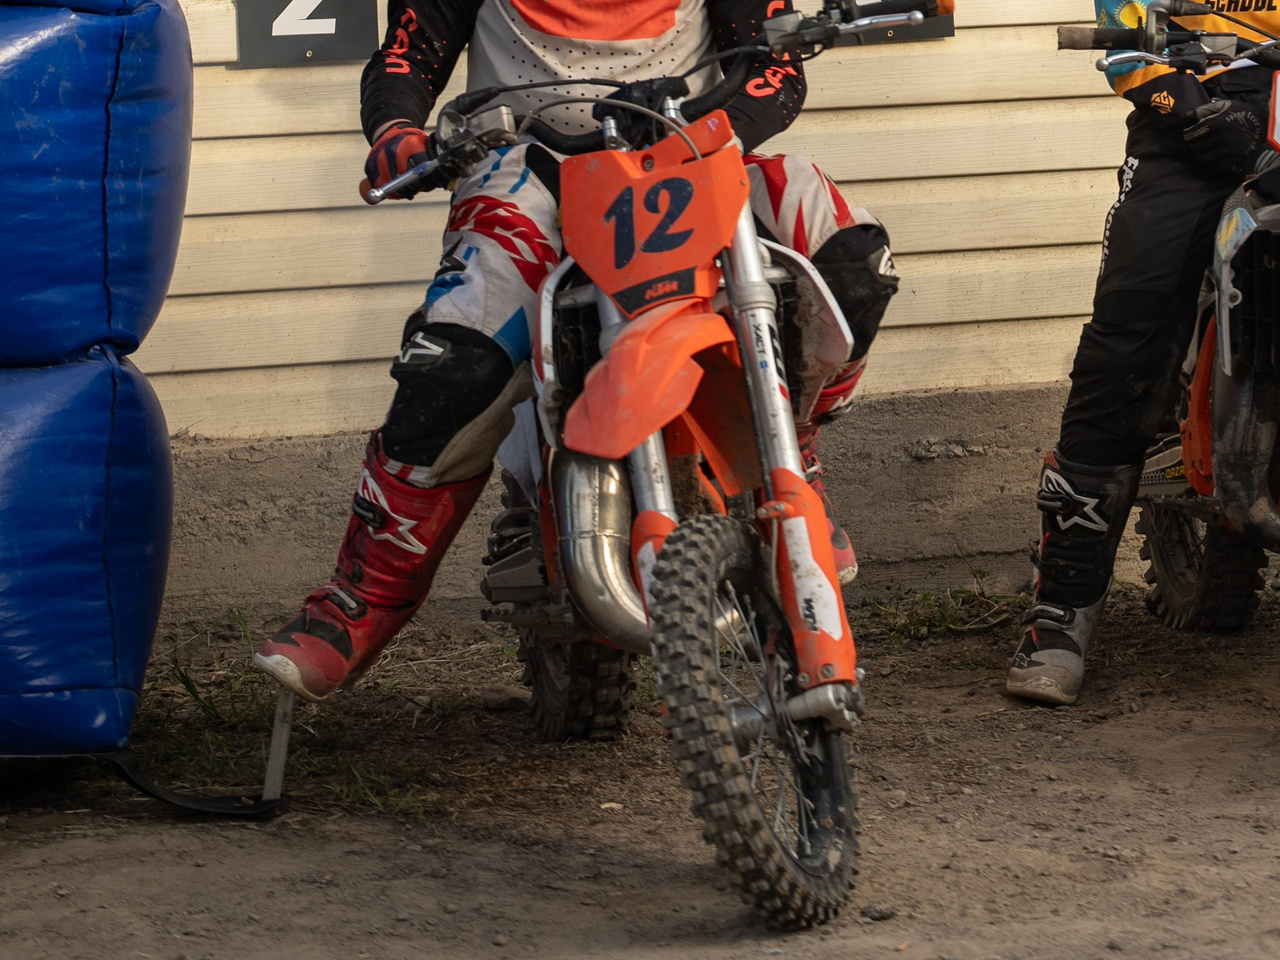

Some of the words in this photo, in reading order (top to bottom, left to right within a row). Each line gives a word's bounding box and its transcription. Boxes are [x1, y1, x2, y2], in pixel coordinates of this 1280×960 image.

[604, 176, 696, 271] 12
[644, 280, 680, 301] KTM
[752, 323, 767, 356] XACT
[802, 597, 820, 633] KTM
